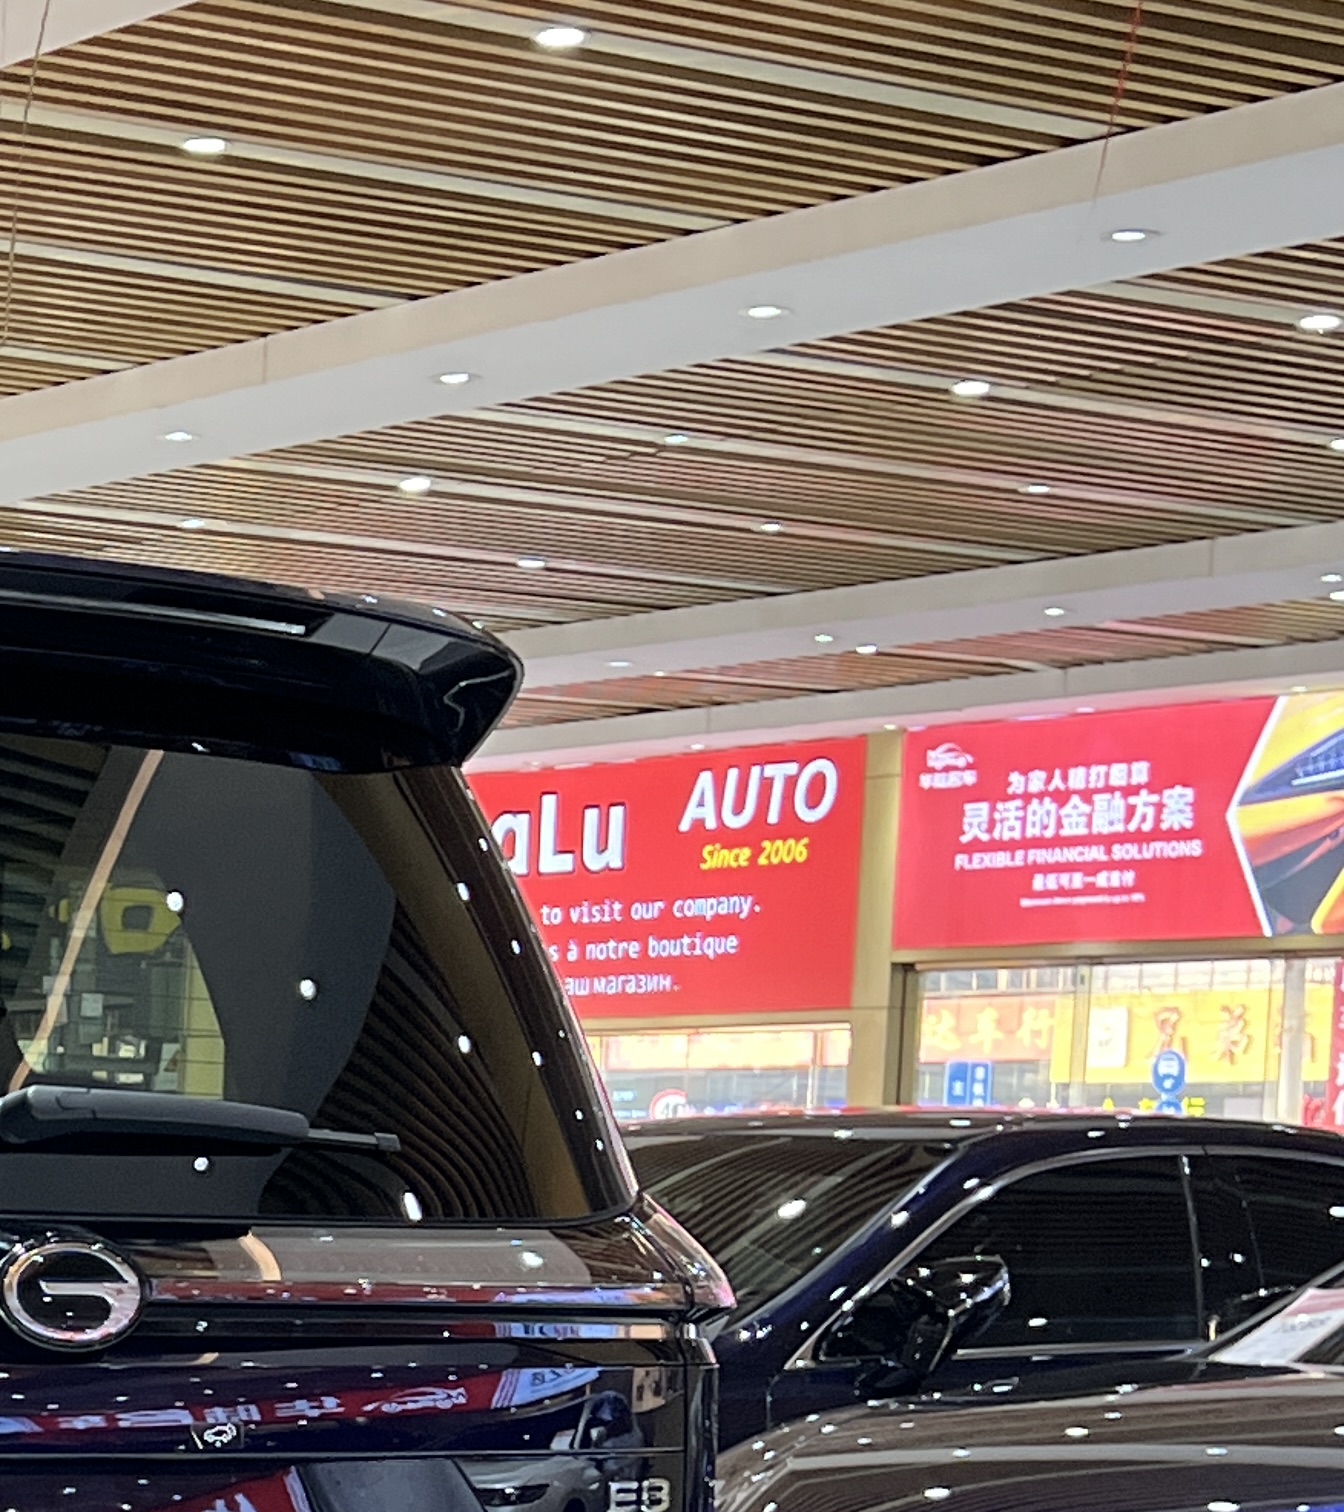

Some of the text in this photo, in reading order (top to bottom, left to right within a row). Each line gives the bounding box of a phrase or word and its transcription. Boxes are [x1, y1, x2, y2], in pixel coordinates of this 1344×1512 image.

[678, 756, 839, 833] AUTO
[959, 785, 1194, 843] 灵活的金融方案
[492, 791, 626, 877] aLu
[700, 838, 810, 870] Since 2006
[954, 839, 1203, 871] FLEXIBLE FINANCIAL SOLUTIONS
[540, 894, 762, 924] to visit our company.
[585, 937, 641, 960] notre
[648, 932, 738, 960] boutique
[564, 975, 589, 996] аш
